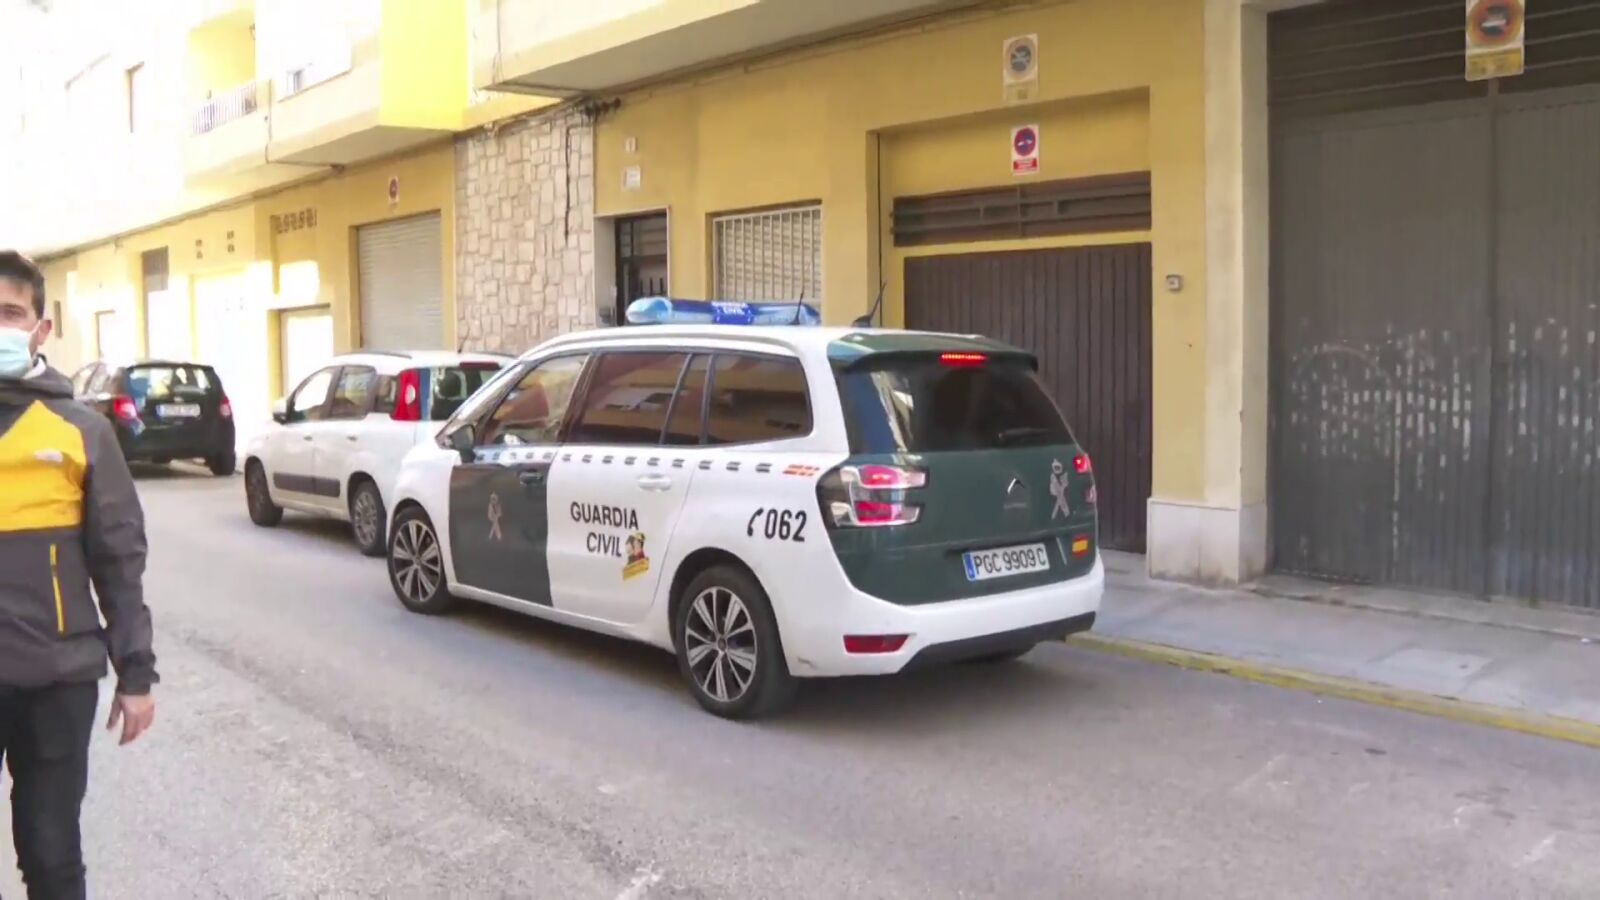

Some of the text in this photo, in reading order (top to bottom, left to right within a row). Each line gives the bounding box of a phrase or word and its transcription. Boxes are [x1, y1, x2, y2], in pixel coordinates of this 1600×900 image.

[570, 501, 639, 530] GUARDIA
[764, 508, 807, 542] 062
[586, 532, 622, 557] CIVIL
